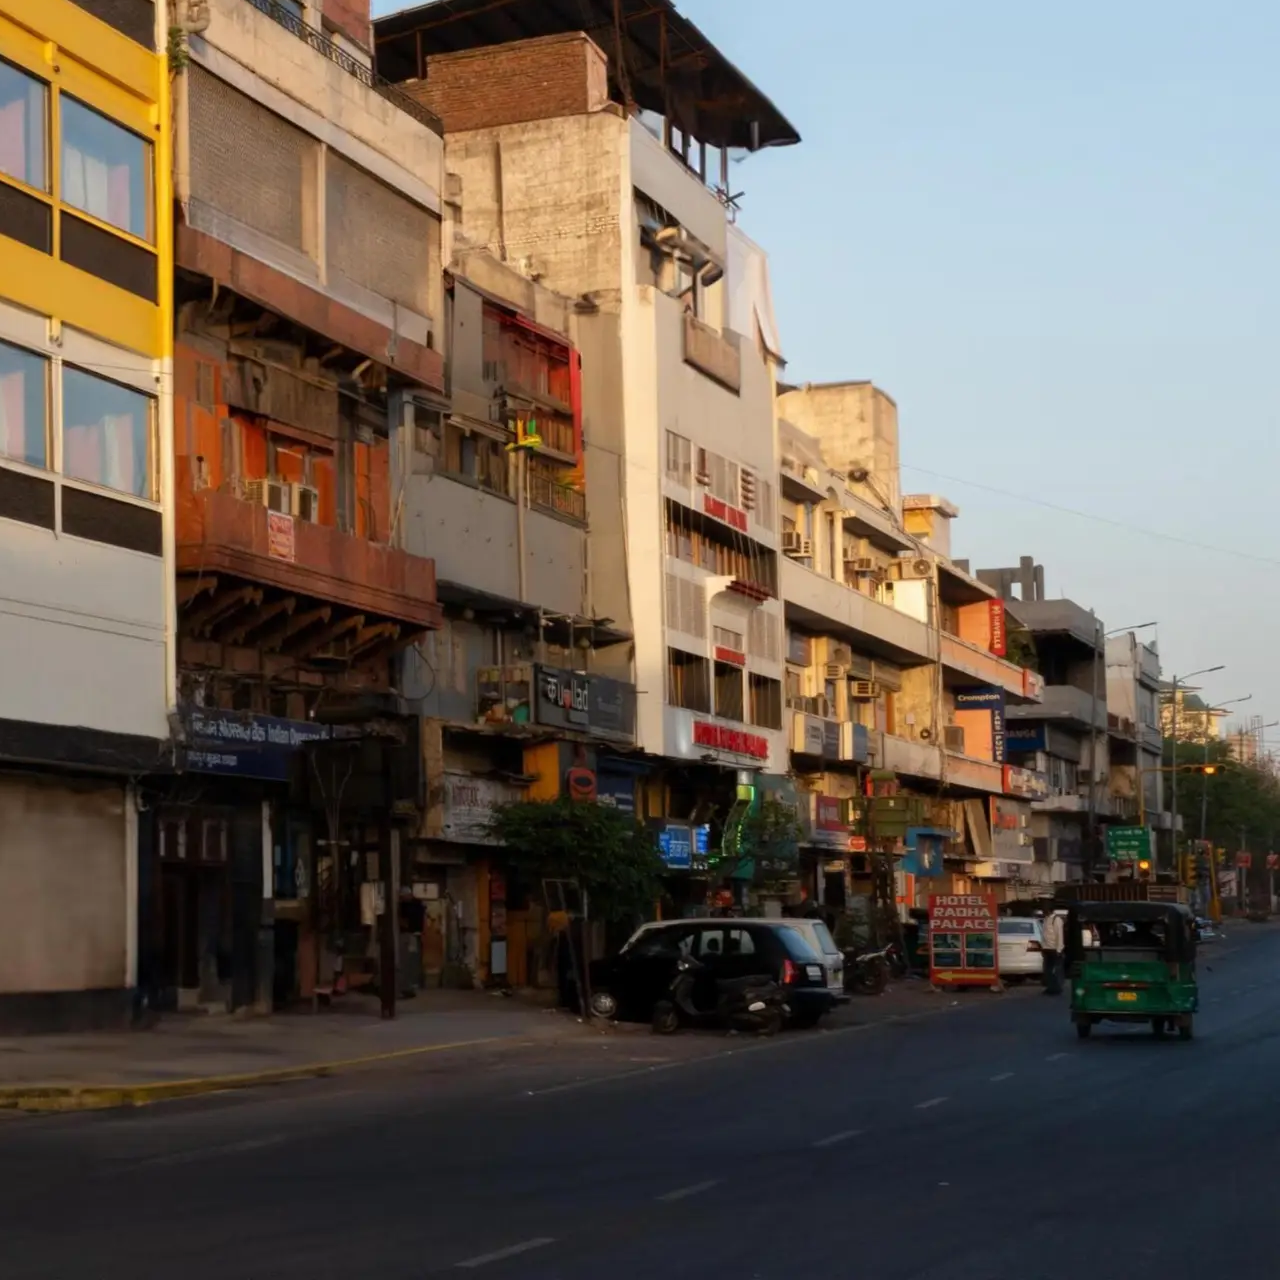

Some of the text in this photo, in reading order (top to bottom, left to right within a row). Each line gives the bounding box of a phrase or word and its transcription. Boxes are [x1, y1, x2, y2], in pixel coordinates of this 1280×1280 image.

[992, 615, 1001, 649] HAVELLS
[957, 694, 1001, 702] Crompton
[267, 723, 289, 744] Indian
[936, 895, 988, 906] HOTEL
[933, 907, 991, 917] RADHA
[930, 919, 995, 929] PALACE
